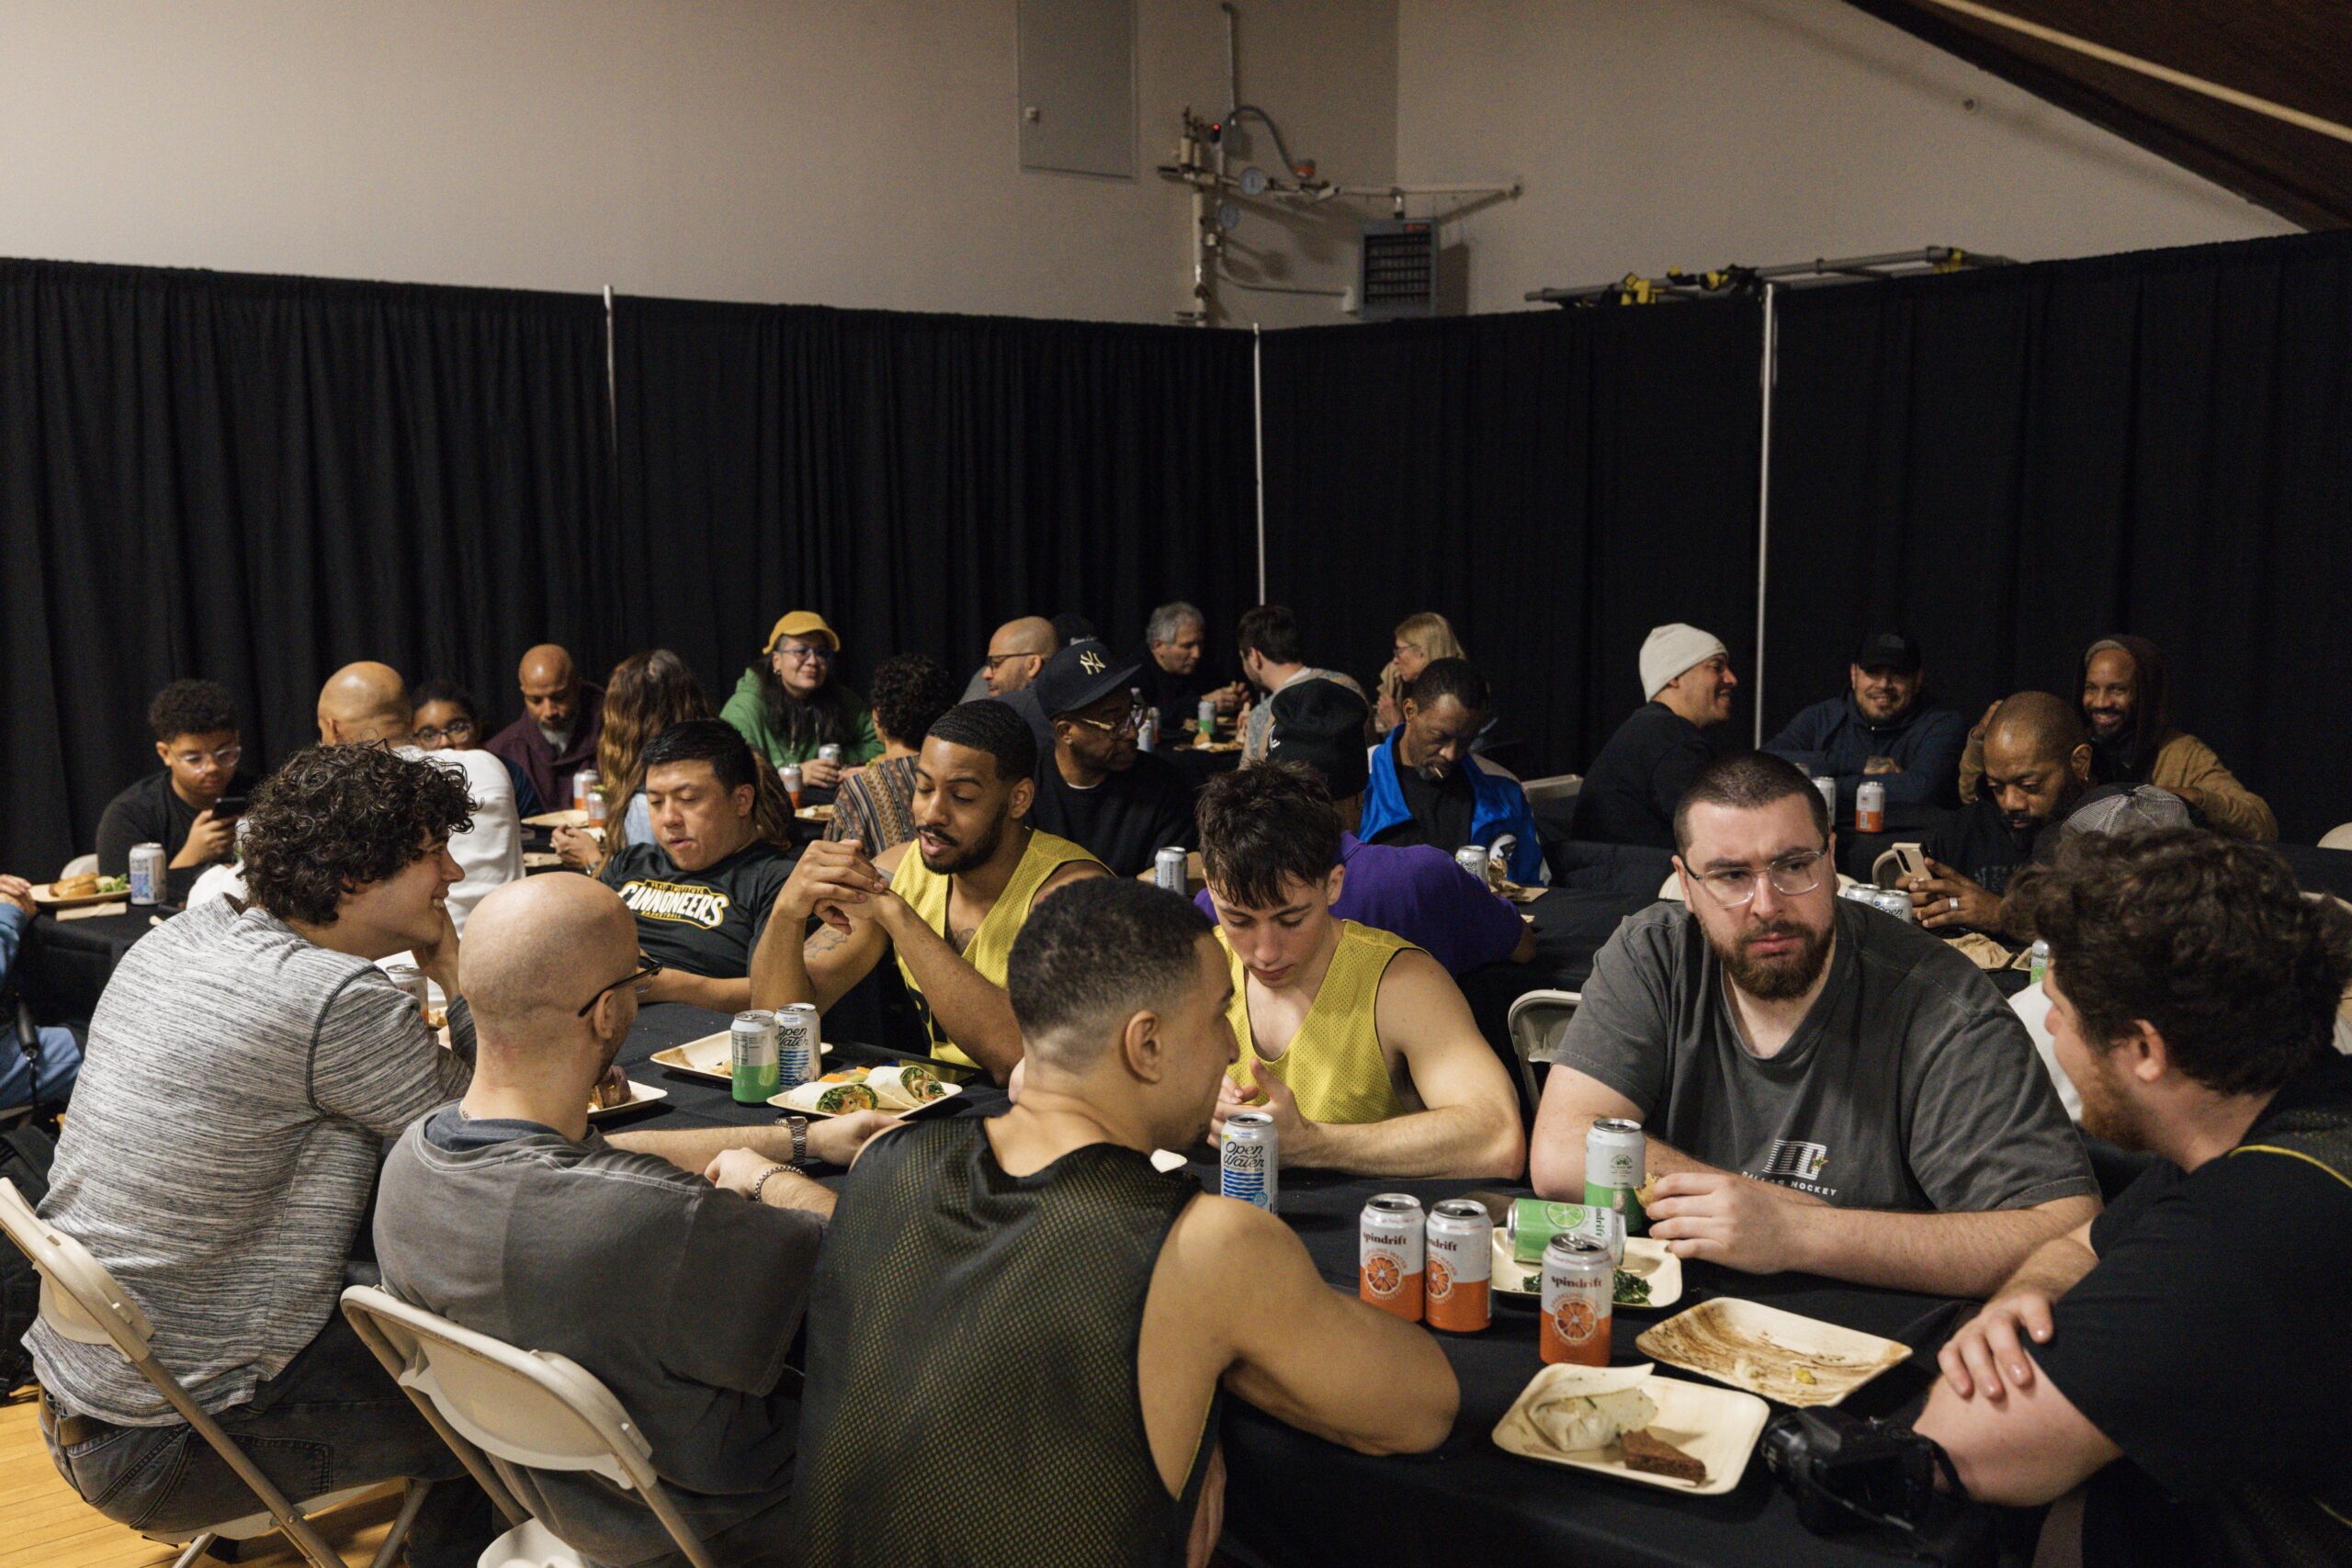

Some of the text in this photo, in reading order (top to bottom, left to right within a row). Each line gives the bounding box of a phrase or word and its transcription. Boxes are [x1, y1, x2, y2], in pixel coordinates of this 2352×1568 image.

[617, 883, 729, 927] CANNONEERS
[1226, 1141, 1263, 1156] Open
[1223, 1154, 1265, 1168] Water
[1791, 1180, 1837, 1196] HOCKEY
[1551, 1275, 1602, 1289] spindrift
